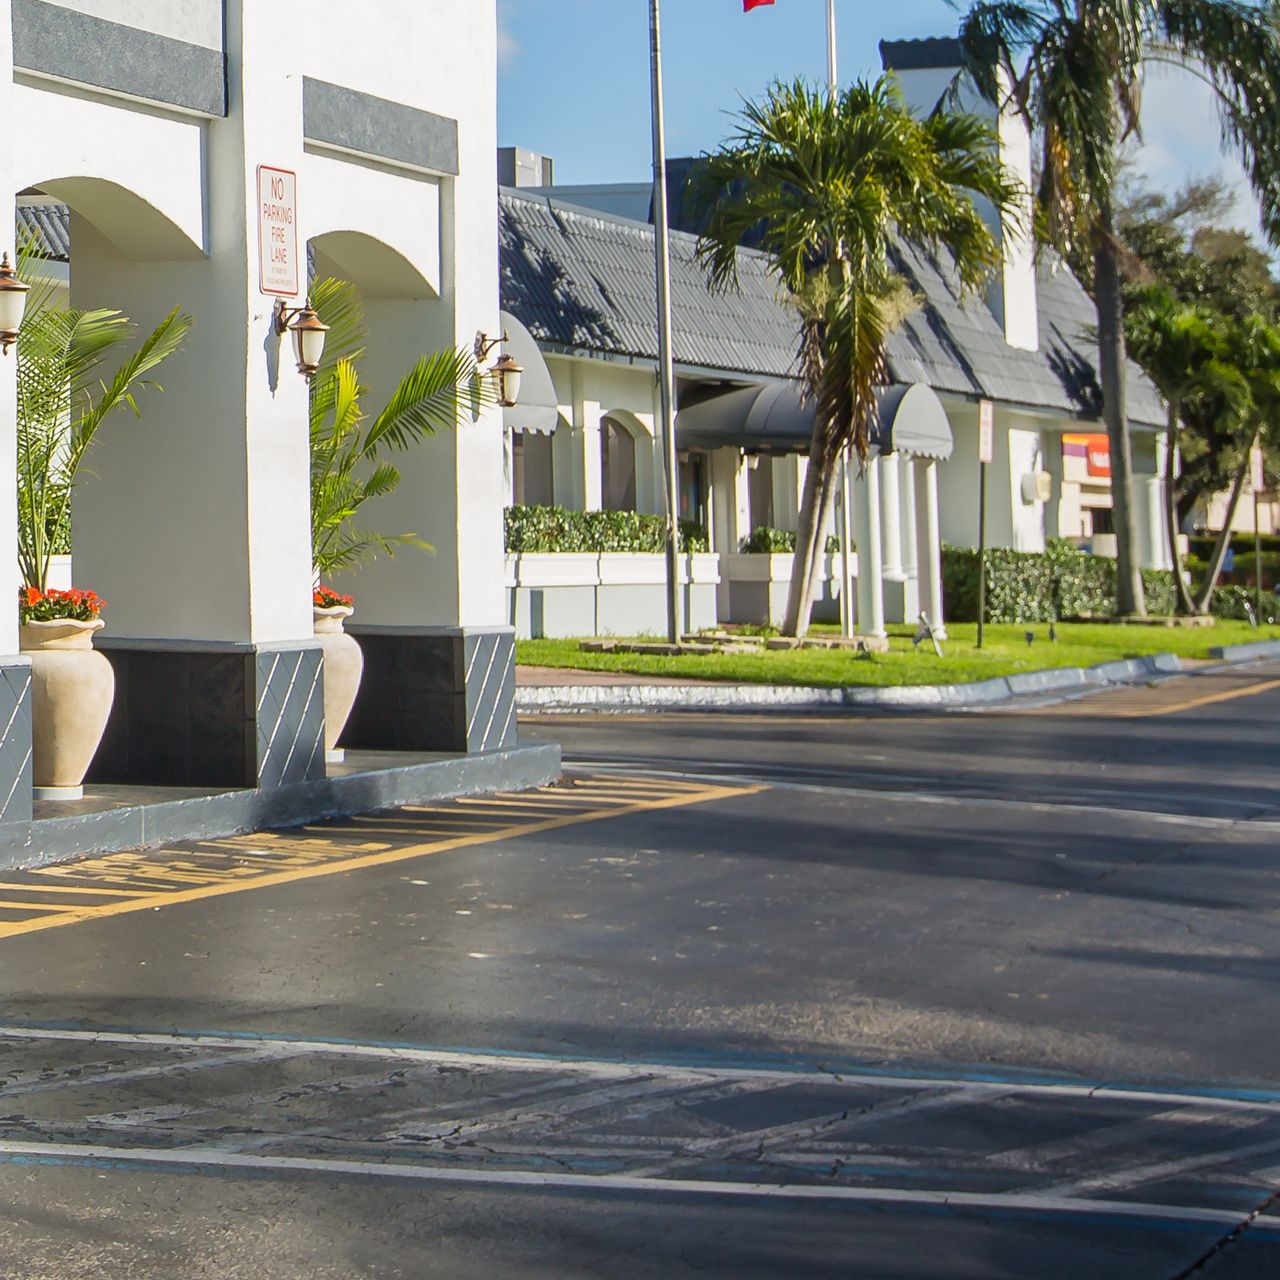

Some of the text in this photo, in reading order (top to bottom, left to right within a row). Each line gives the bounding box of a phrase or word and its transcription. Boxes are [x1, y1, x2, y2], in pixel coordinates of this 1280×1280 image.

[271, 177, 284, 200] NO
[263, 203, 292, 224] PARKING
[271, 226, 285, 244] FIRE
[271, 248, 287, 264] LANE
